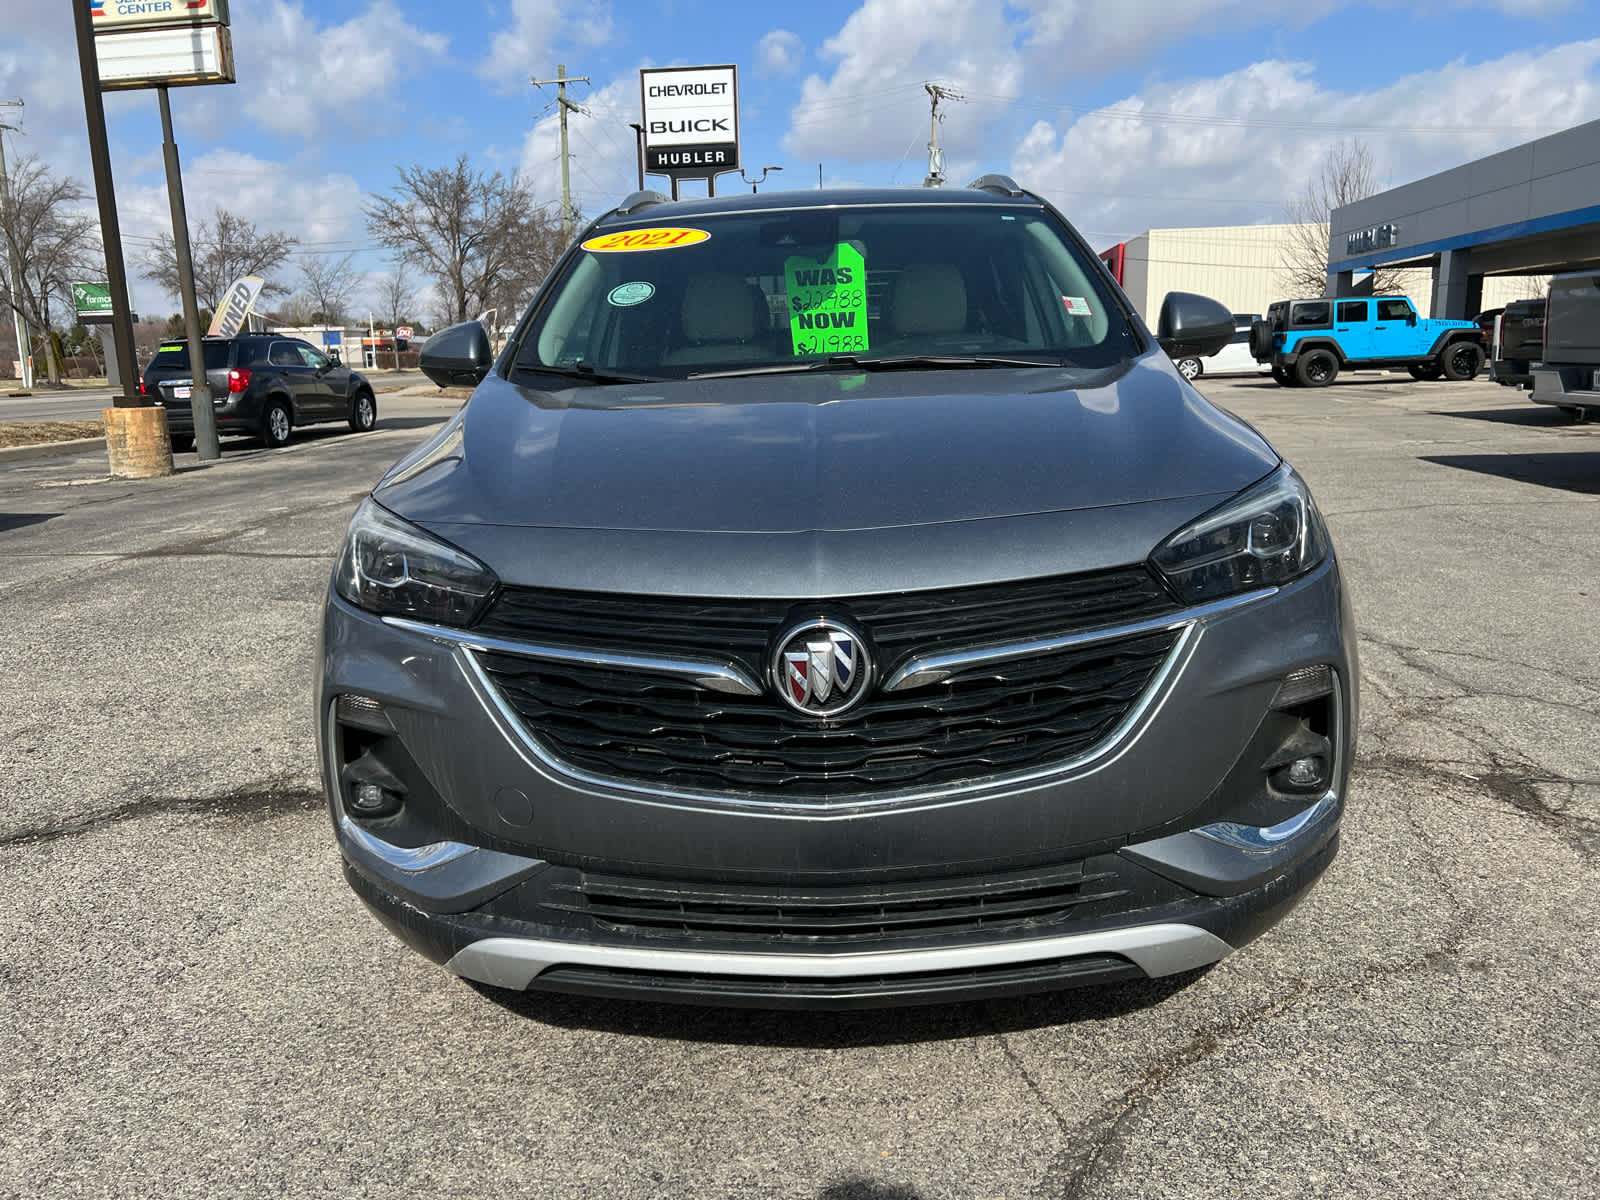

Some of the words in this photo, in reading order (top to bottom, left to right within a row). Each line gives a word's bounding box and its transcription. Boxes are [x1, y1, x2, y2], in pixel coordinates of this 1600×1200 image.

[117, 1, 173, 15] CENTER
[649, 82, 728, 97] CHEVROLET
[650, 118, 730, 134] BUICK
[658, 151, 725, 165] HUBLER
[600, 231, 691, 249] 2021
[794, 266, 853, 287] WAS
[798, 311, 856, 330] NOW
